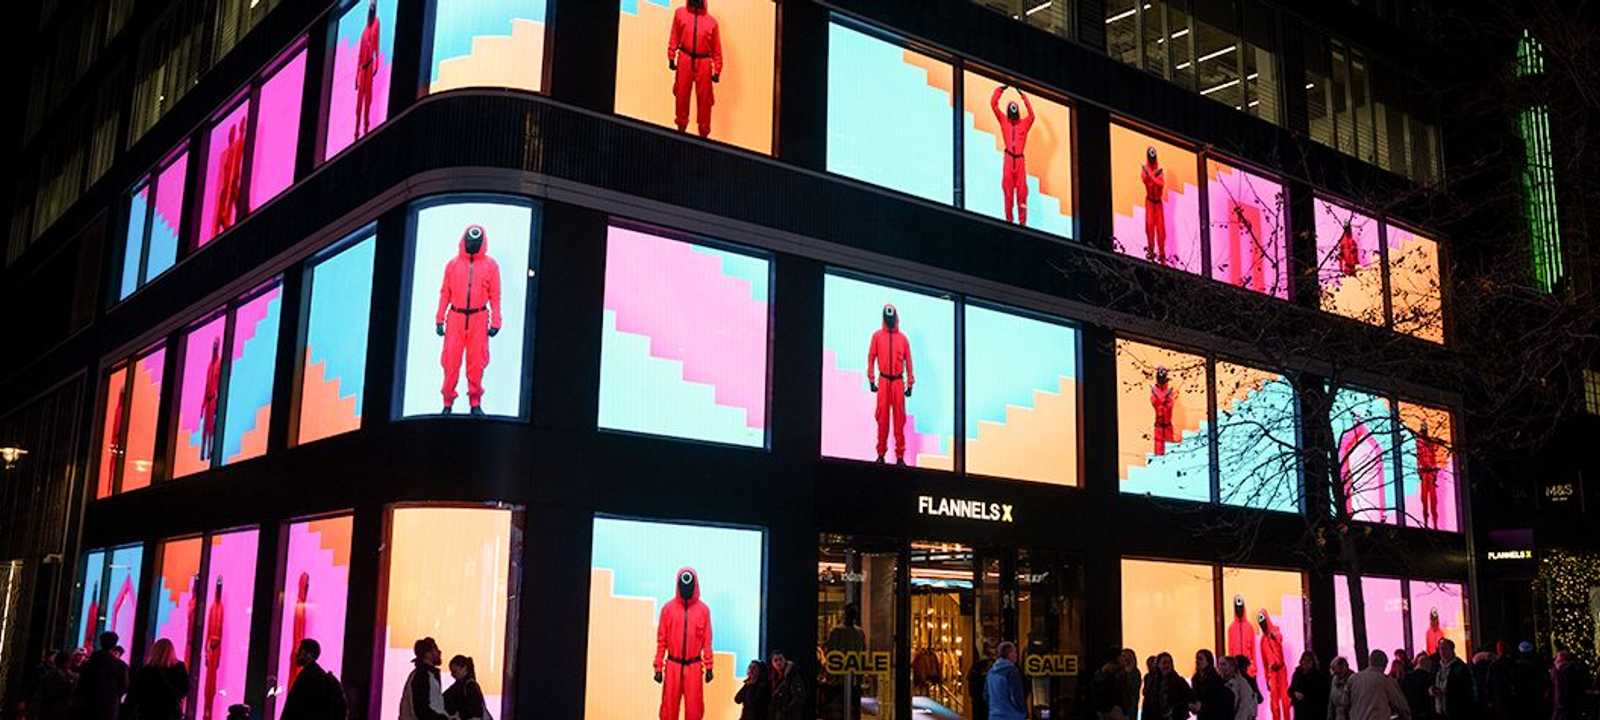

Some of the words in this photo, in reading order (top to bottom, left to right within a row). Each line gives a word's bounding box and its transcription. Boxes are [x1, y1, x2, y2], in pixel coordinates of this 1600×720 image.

[1545, 483, 1573, 497] M&S
[918, 495, 1000, 522] FLANNELS
[1001, 504, 1013, 522] X
[1487, 550, 1524, 560] FLANNELS
[826, 652, 889, 673] SALE
[1026, 655, 1078, 675] SALE
